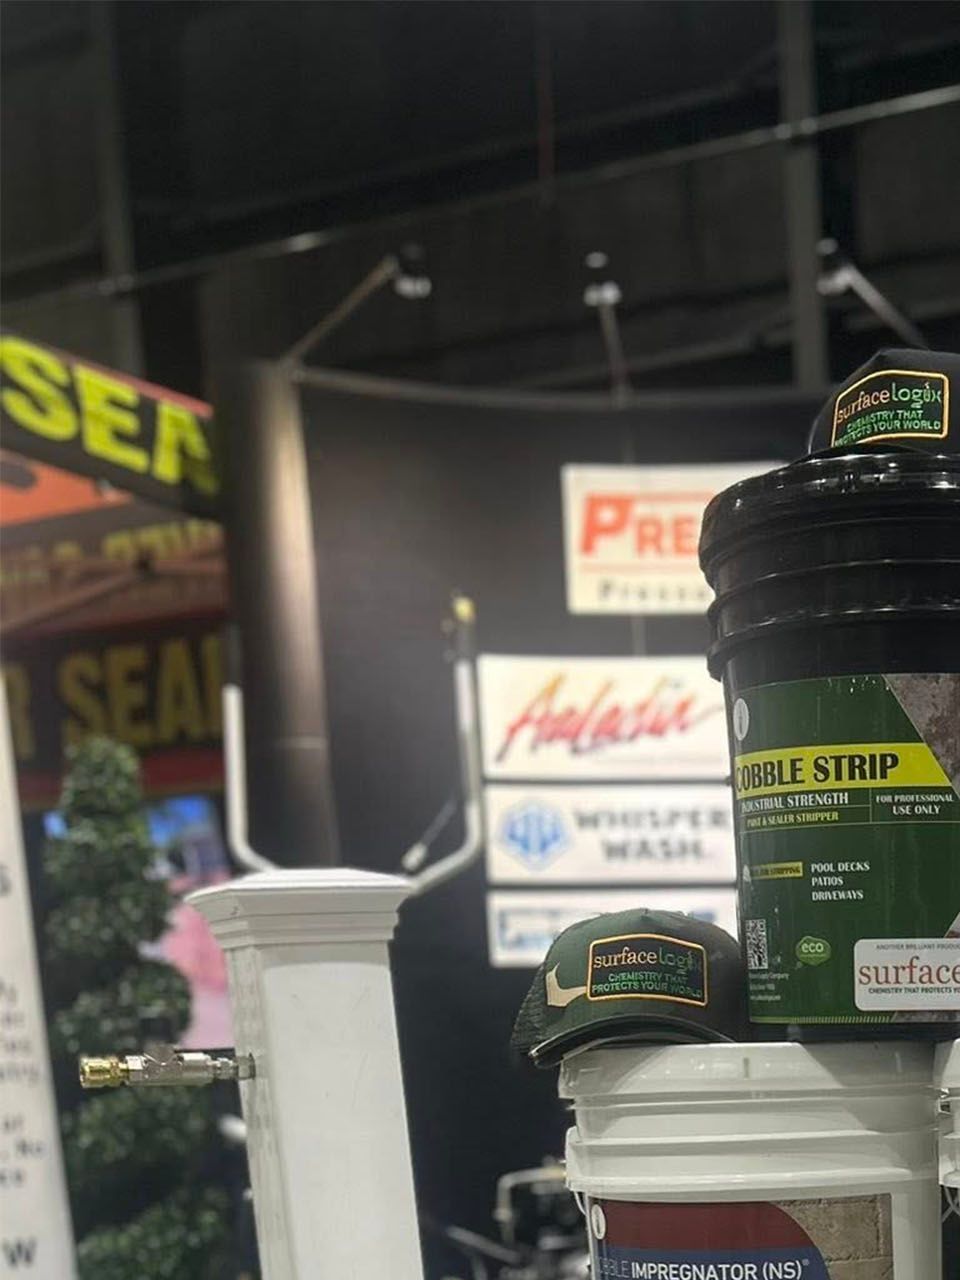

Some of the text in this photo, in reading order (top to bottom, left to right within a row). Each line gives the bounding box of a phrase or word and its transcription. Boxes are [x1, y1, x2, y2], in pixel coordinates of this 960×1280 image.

[896, 410, 924, 420] THAT
[873, 421, 941, 432] YOUR WORLD
[813, 752, 900, 783] STRIP
[787, 792, 849, 808] STRENGTH
[893, 805, 941, 815] USE ONLY
[575, 808, 727, 830] WHISPER
[796, 811, 839, 822] STRIPPER
[811, 861, 870, 873] POOL DECKS
[811, 876, 844, 886] PATIOS
[811, 890, 864, 901] DRIVEWAYS
[801, 943, 824, 953] eco
[631, 1262, 758, 1280] IMPREGNATOR
